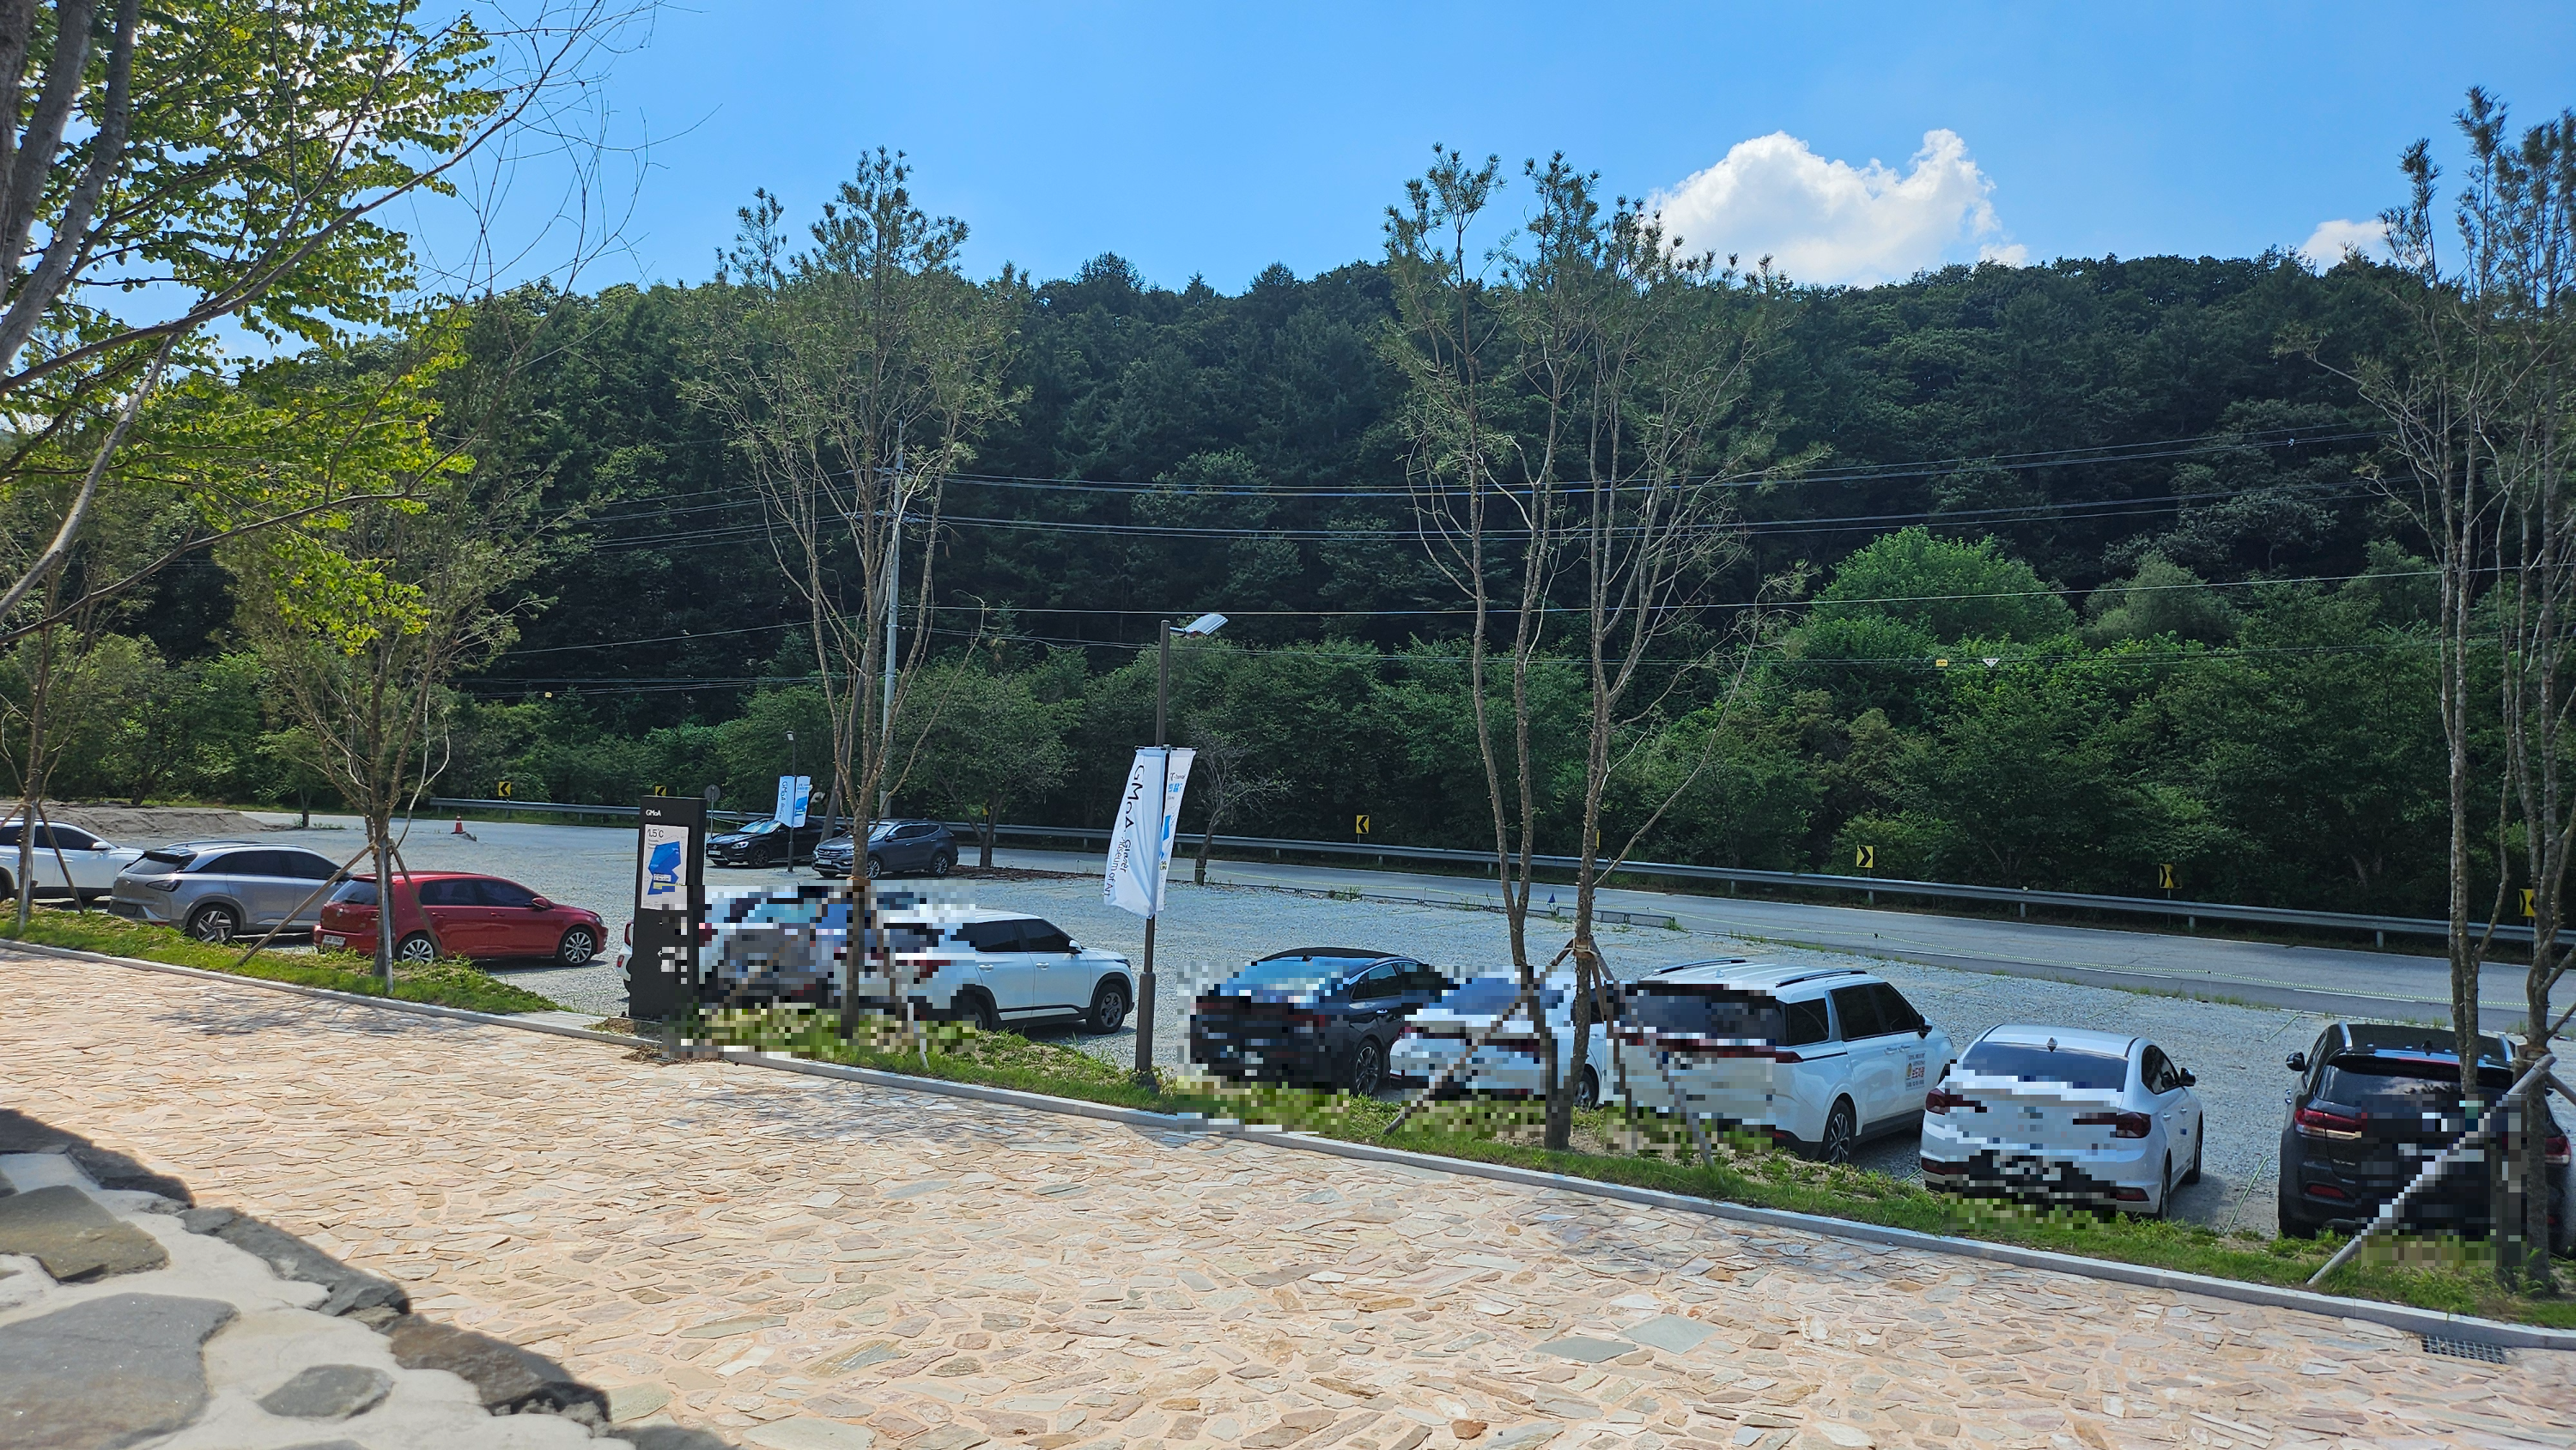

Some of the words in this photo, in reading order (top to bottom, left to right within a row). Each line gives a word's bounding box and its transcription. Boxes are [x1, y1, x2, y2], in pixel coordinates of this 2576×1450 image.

[1126, 765, 1145, 829] GMoA
[1108, 872, 1115, 883] of
[1103, 883, 1114, 897] Art
